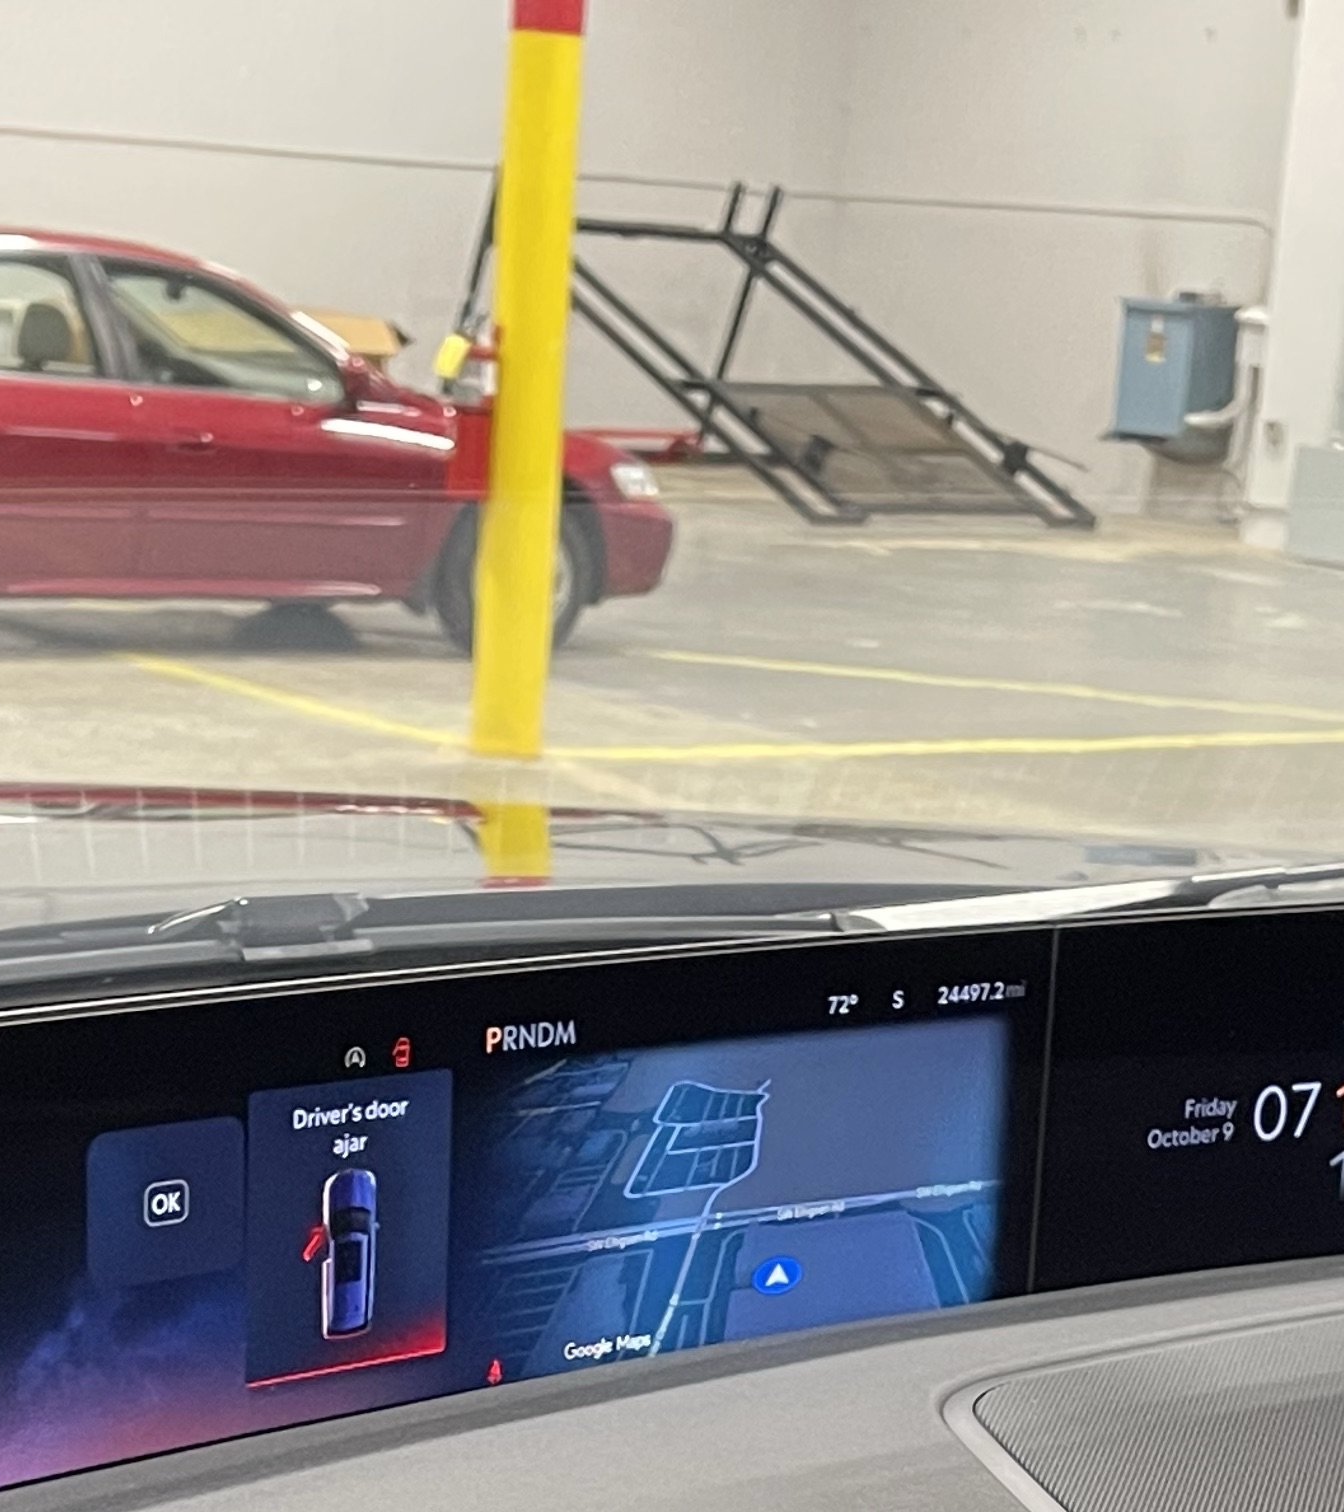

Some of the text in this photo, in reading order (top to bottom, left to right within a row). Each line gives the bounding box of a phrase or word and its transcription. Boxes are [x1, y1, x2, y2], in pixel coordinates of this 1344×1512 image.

[892, 990, 905, 1009] S
[292, 1100, 409, 1130] Driver's door
[1184, 1099, 1237, 1120] Friday
[1253, 1081, 1323, 1142] 07
[332, 1135, 369, 1159] ajar
[1147, 1122, 1235, 1149] October 9
[151, 1192, 182, 1216] OK
[564, 1334, 651, 1360] Google Maps
